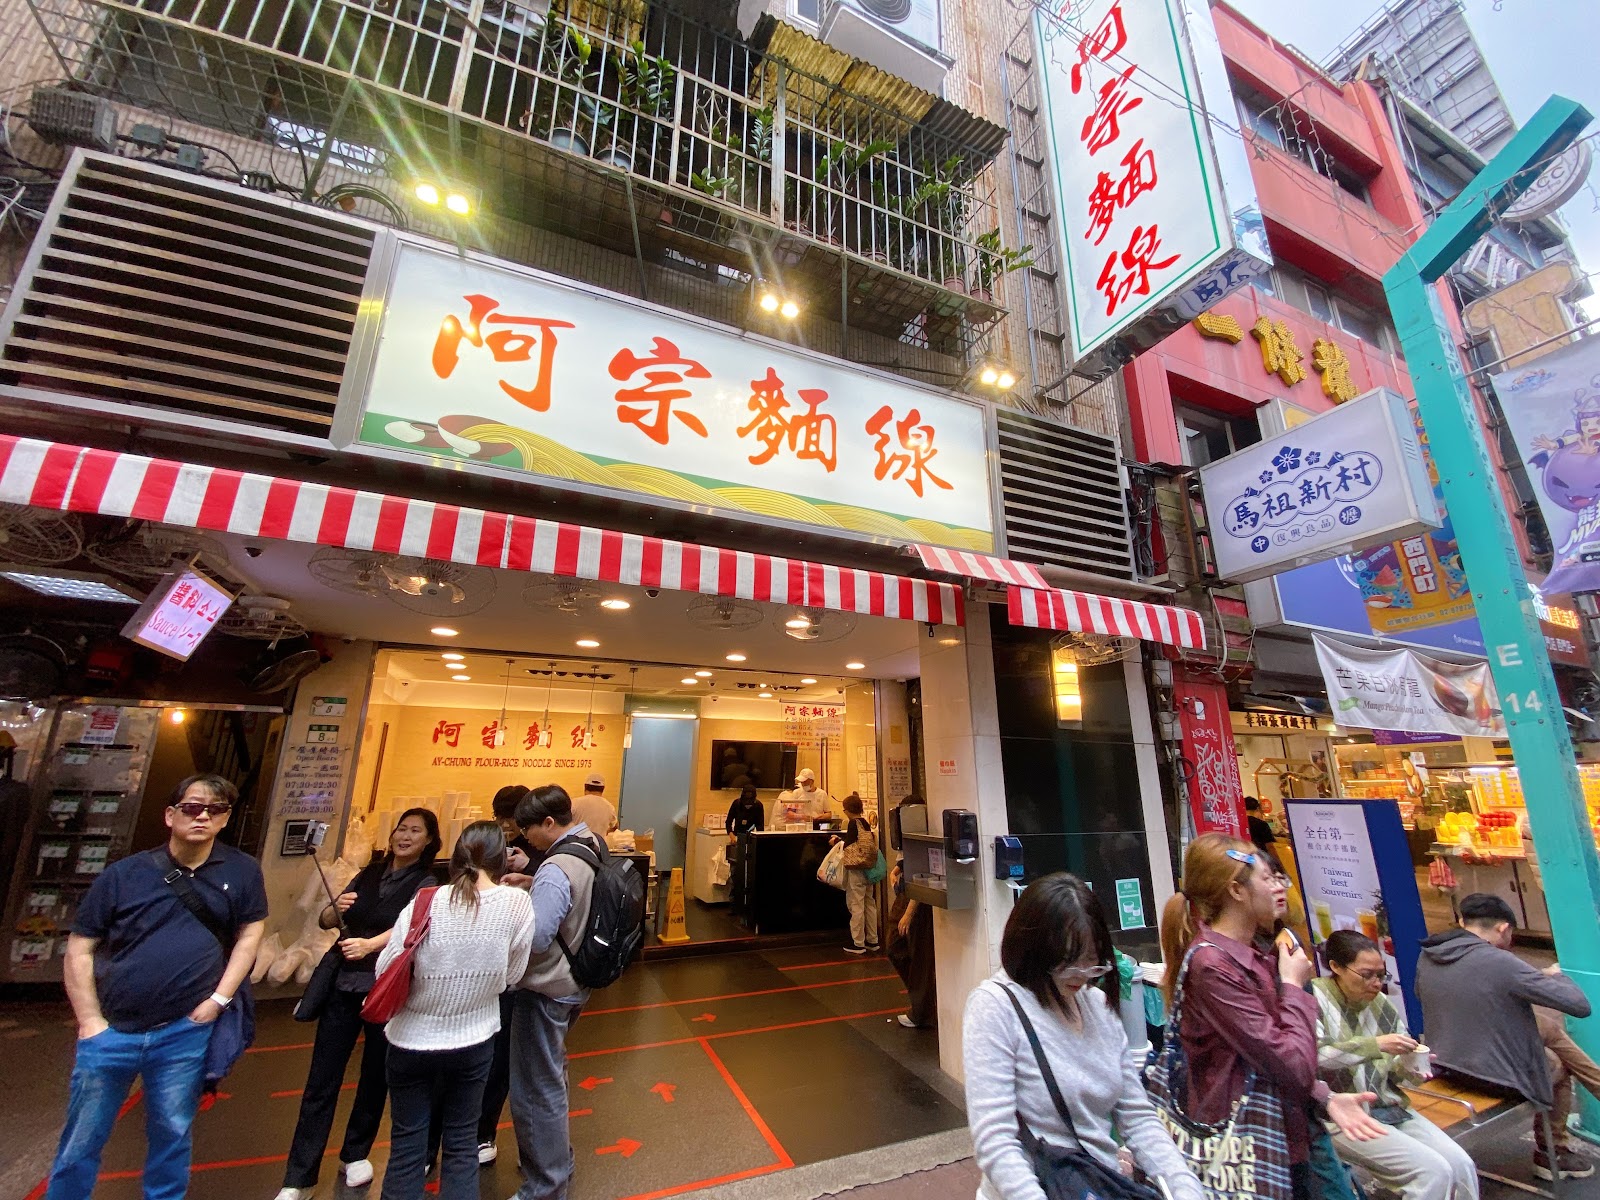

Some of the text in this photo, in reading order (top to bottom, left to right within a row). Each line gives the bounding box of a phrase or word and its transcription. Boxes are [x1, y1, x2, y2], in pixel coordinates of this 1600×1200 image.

[1071, 0, 1182, 317] 阿宗麵線
[432, 294, 954, 498] 阿宗麵線
[1232, 457, 1372, 533] 馬祖新村
[1402, 537, 1437, 593] 西門町
[169, 580, 203, 613] 醬料
[196, 600, 221, 623] 소스
[148, 610, 179, 637] Sauce
[178, 626, 202, 647] ソース
[1496, 643, 1523, 667] E
[785, 705, 839, 718] 阿宗麵線
[1362, 700, 1385, 712] Mango
[1505, 690, 1543, 713] 14
[318, 732, 326, 742] 8
[296, 755, 315, 763] Open
[431, 757, 592, 768] AY-CHUNG FLOUR-RICE NOODLE SINCE 1975
[1304, 826, 1355, 841] 全台第一
[1321, 866, 1354, 878] Taiwan
[1330, 878, 1349, 887] Best
[1321, 887, 1363, 900] Souvenirs
